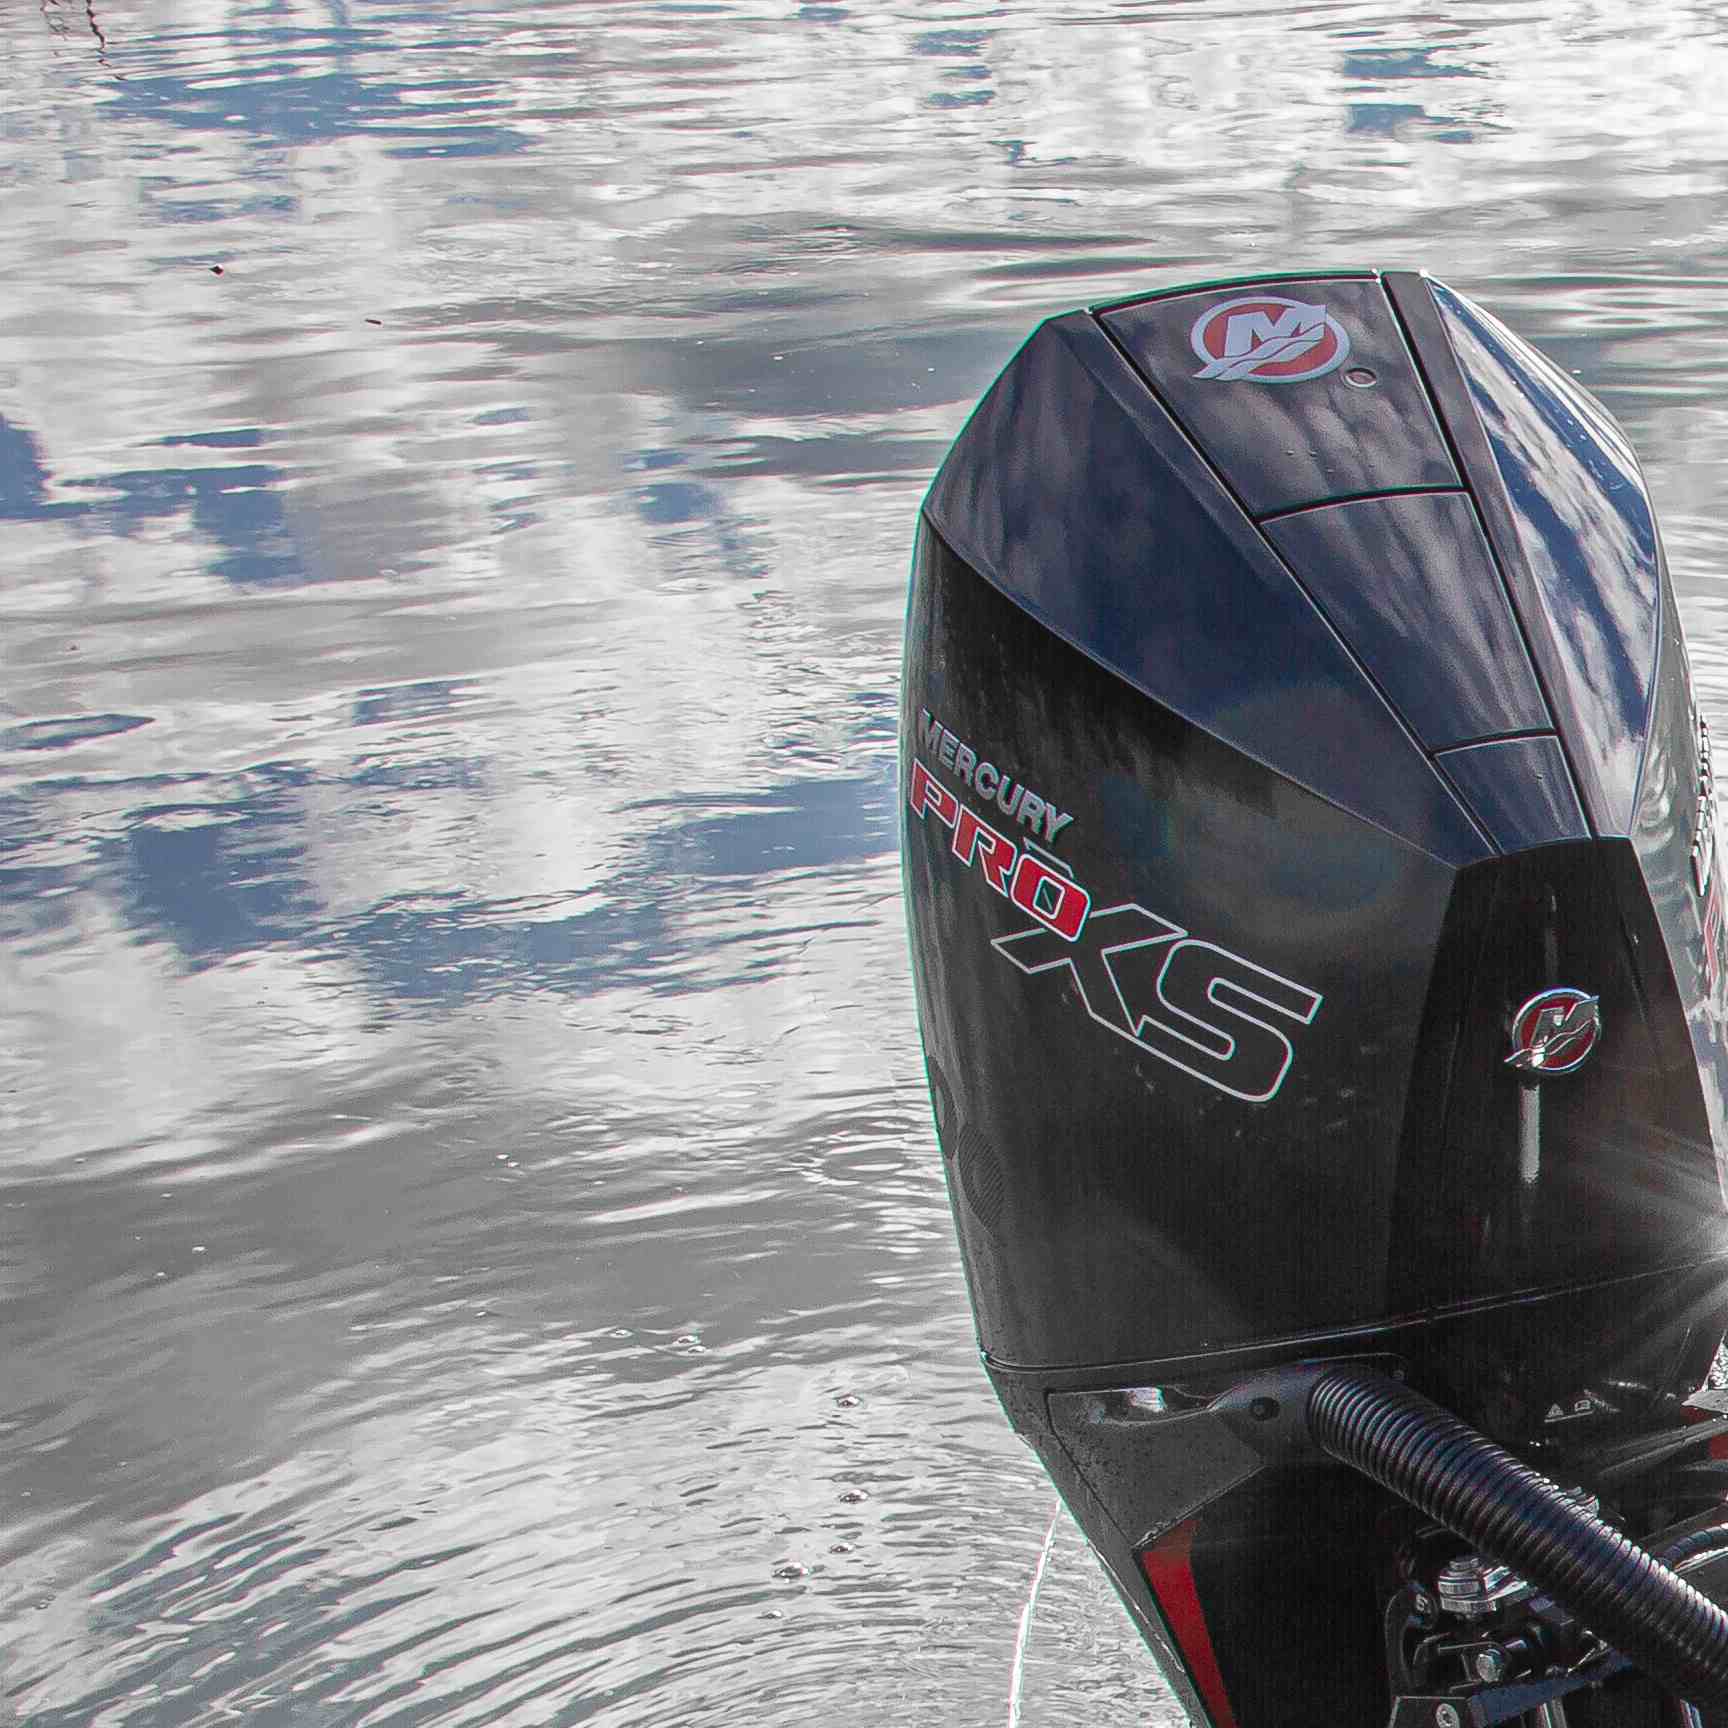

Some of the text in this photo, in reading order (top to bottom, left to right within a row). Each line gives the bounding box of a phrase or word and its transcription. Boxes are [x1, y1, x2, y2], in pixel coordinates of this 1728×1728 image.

[917, 707, 1074, 843] MERCURY
[910, 758, 1323, 1103] PRO XS
